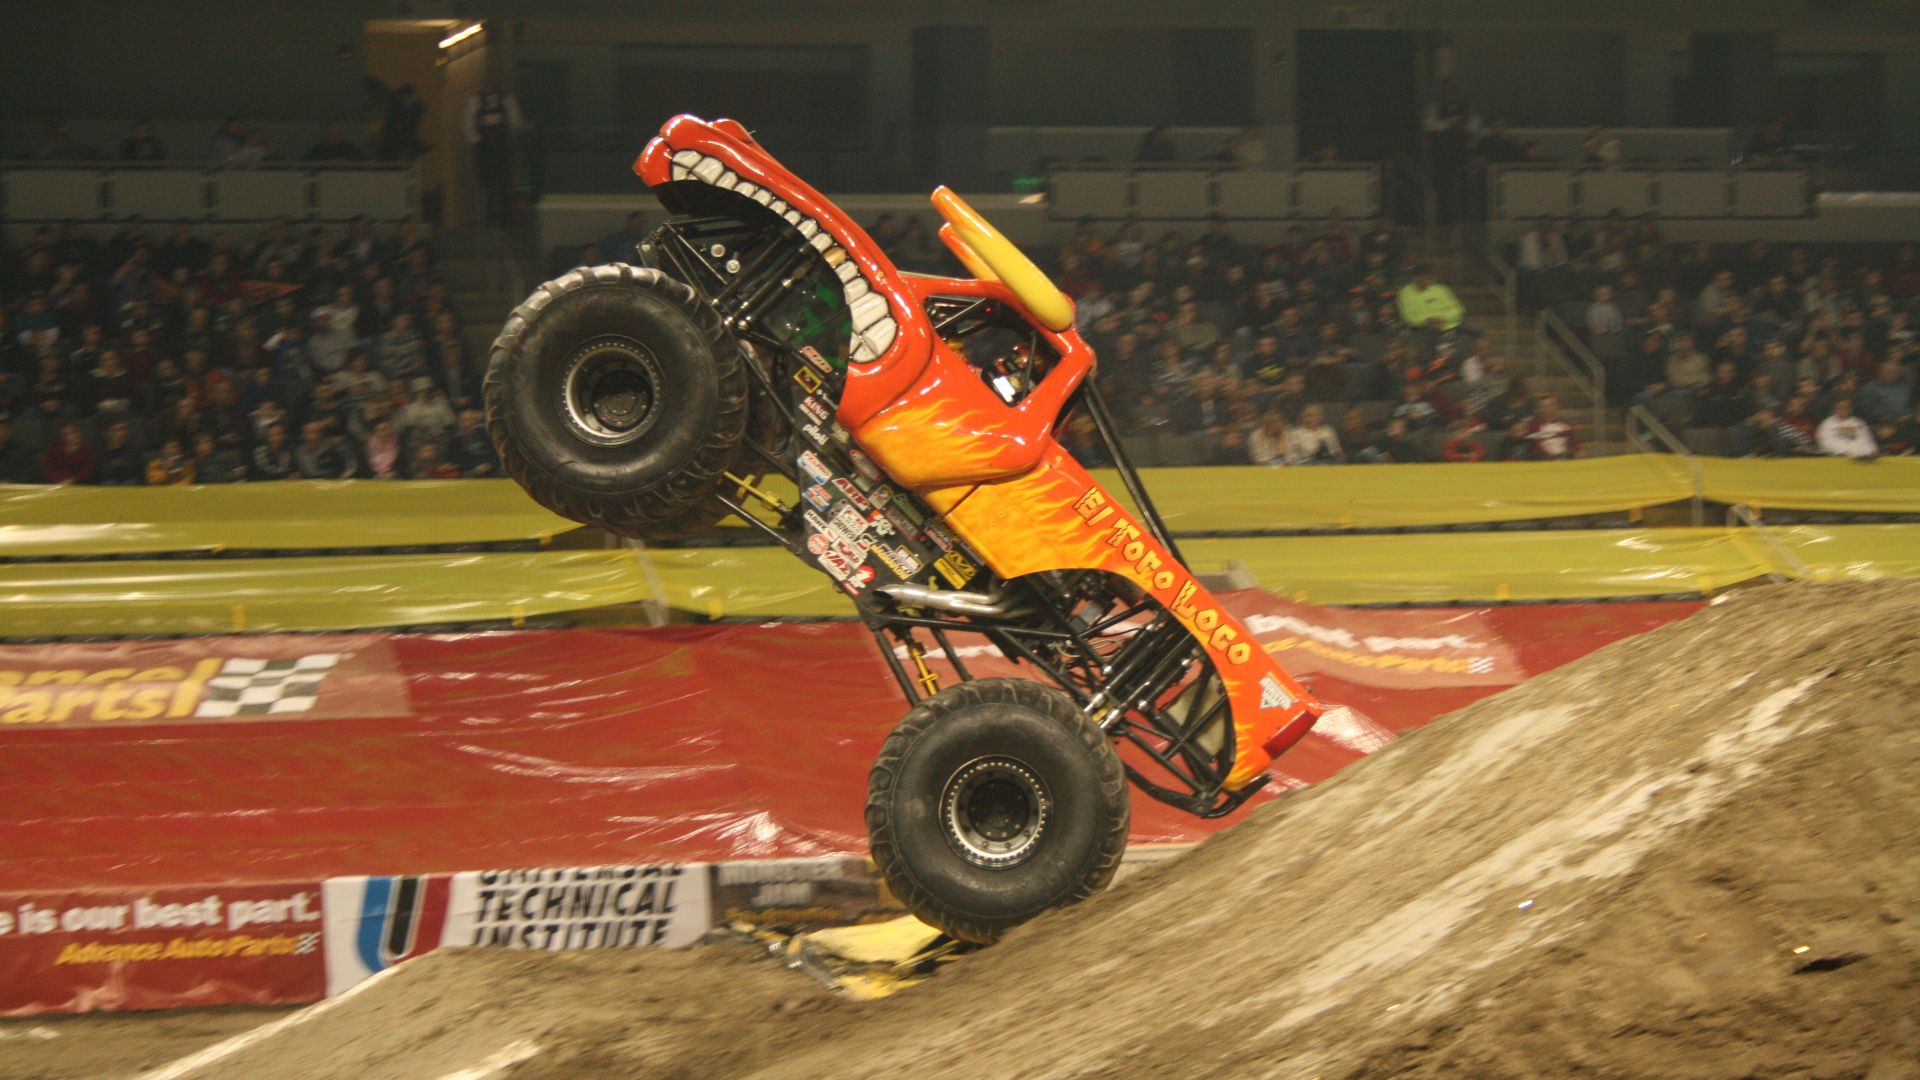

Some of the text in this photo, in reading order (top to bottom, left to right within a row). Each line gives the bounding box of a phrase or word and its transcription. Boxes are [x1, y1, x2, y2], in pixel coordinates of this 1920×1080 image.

[803, 396, 830, 420] KING
[17, 902, 58, 934] is
[60, 905, 129, 932] our
[133, 896, 223, 928] best
[228, 893, 320, 931] part.
[475, 880, 678, 922] TECHNICAL
